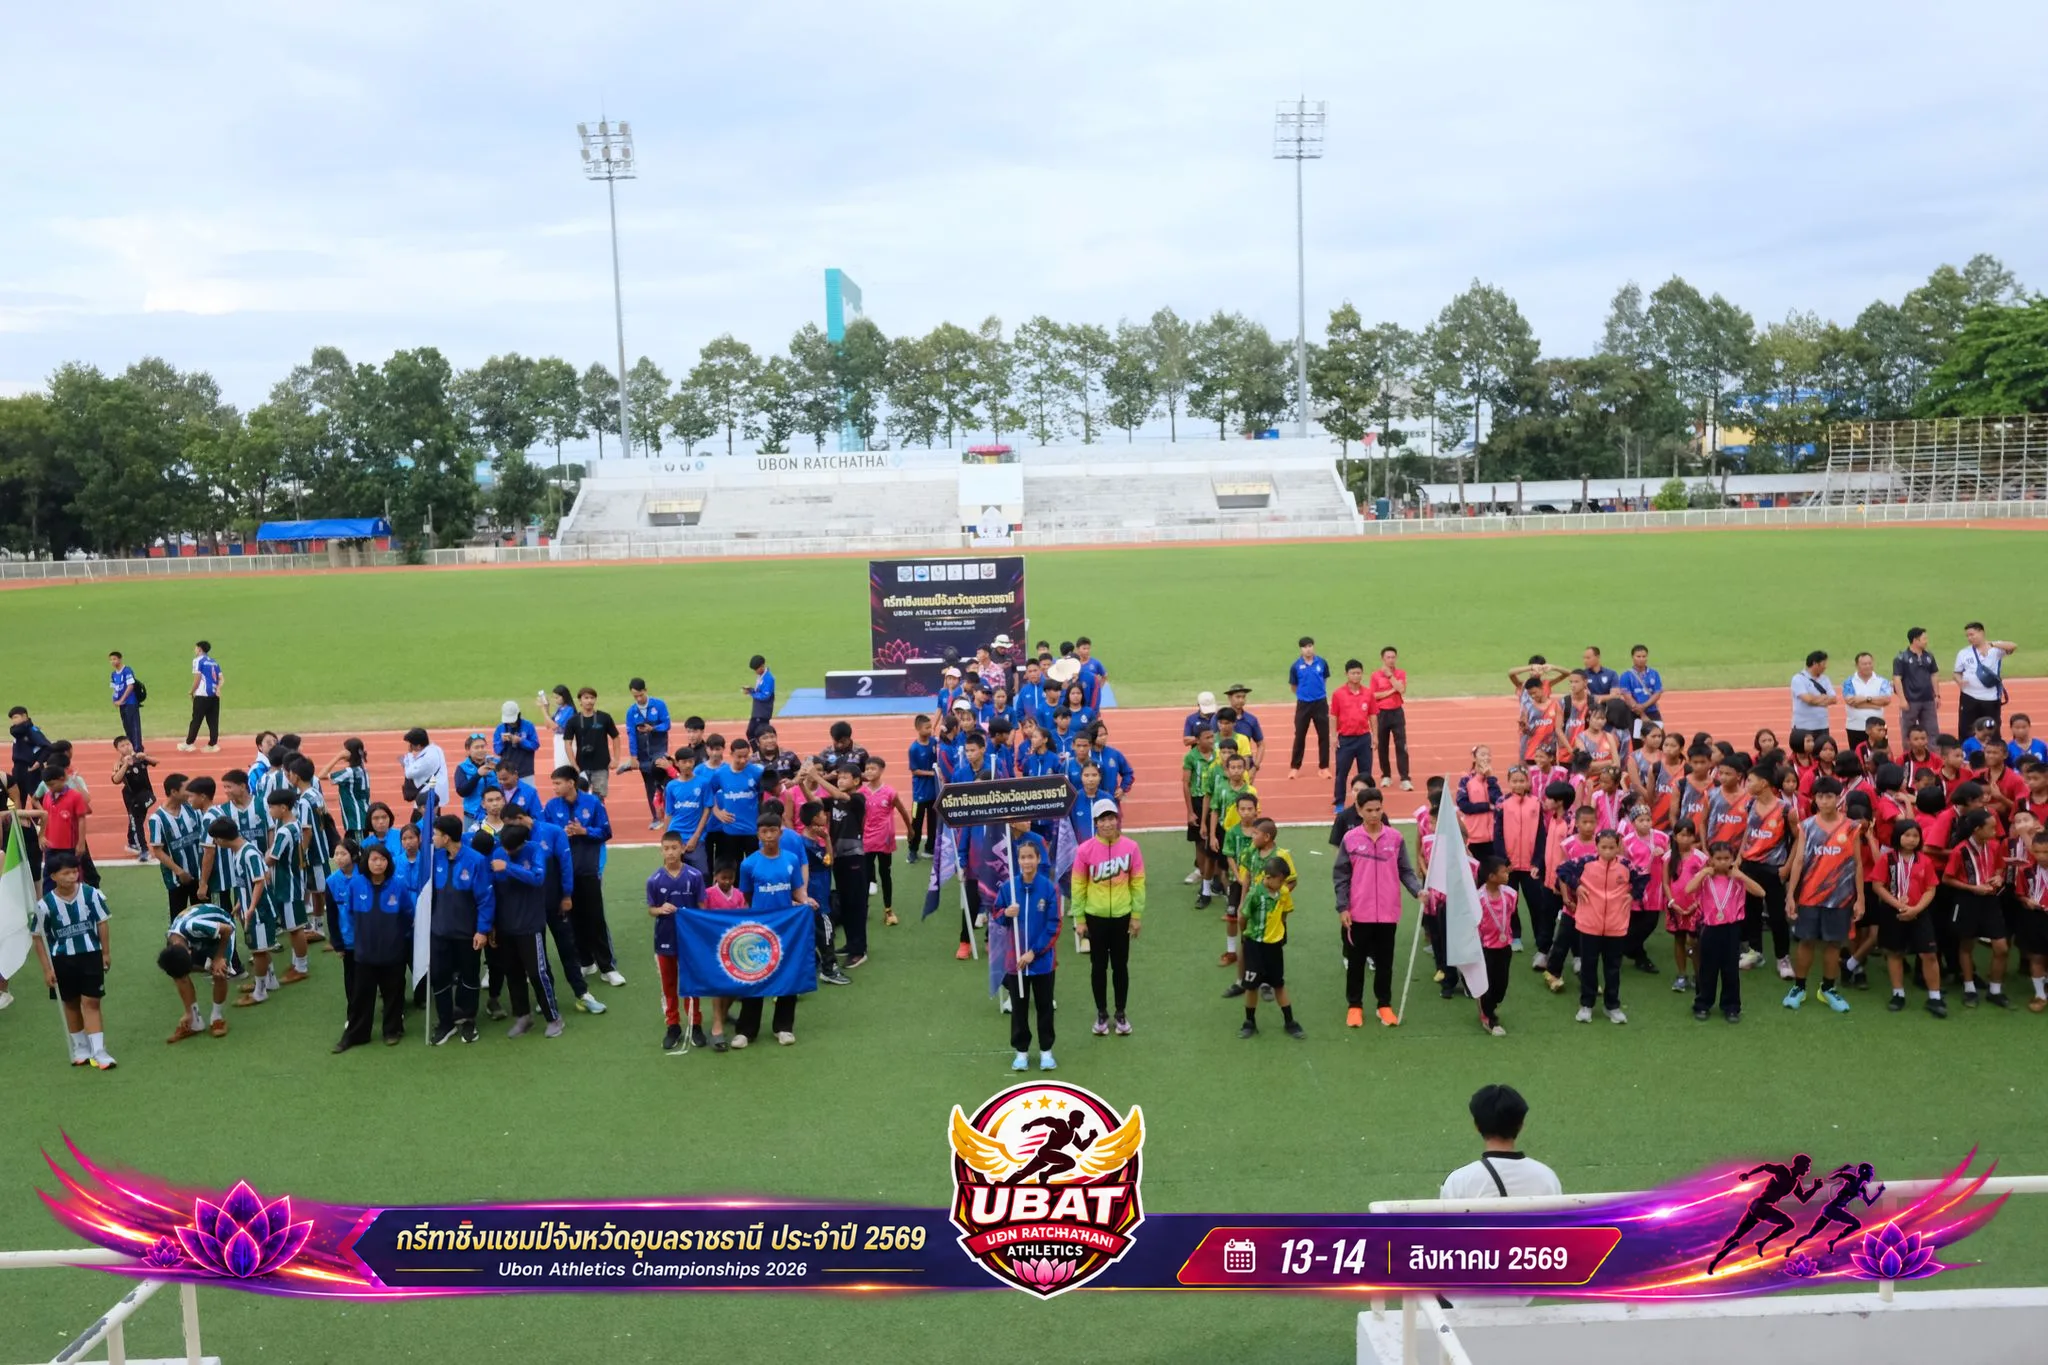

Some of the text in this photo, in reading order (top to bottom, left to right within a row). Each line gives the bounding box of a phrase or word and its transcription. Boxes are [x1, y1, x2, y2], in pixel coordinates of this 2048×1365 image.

[758, 458, 798, 471] UBON
[915, 608, 952, 616] ATHLETICS
[953, 606, 1007, 615] CHAMPIONSHIPS
[856, 677, 873, 696] 2
[948, 802, 1065, 819] UBON ATHLETICS CHAMPIONSHIPS
[1717, 814, 1742, 824] KNP
[1814, 845, 1841, 855] KNP
[1245, 970, 1257, 982] 17
